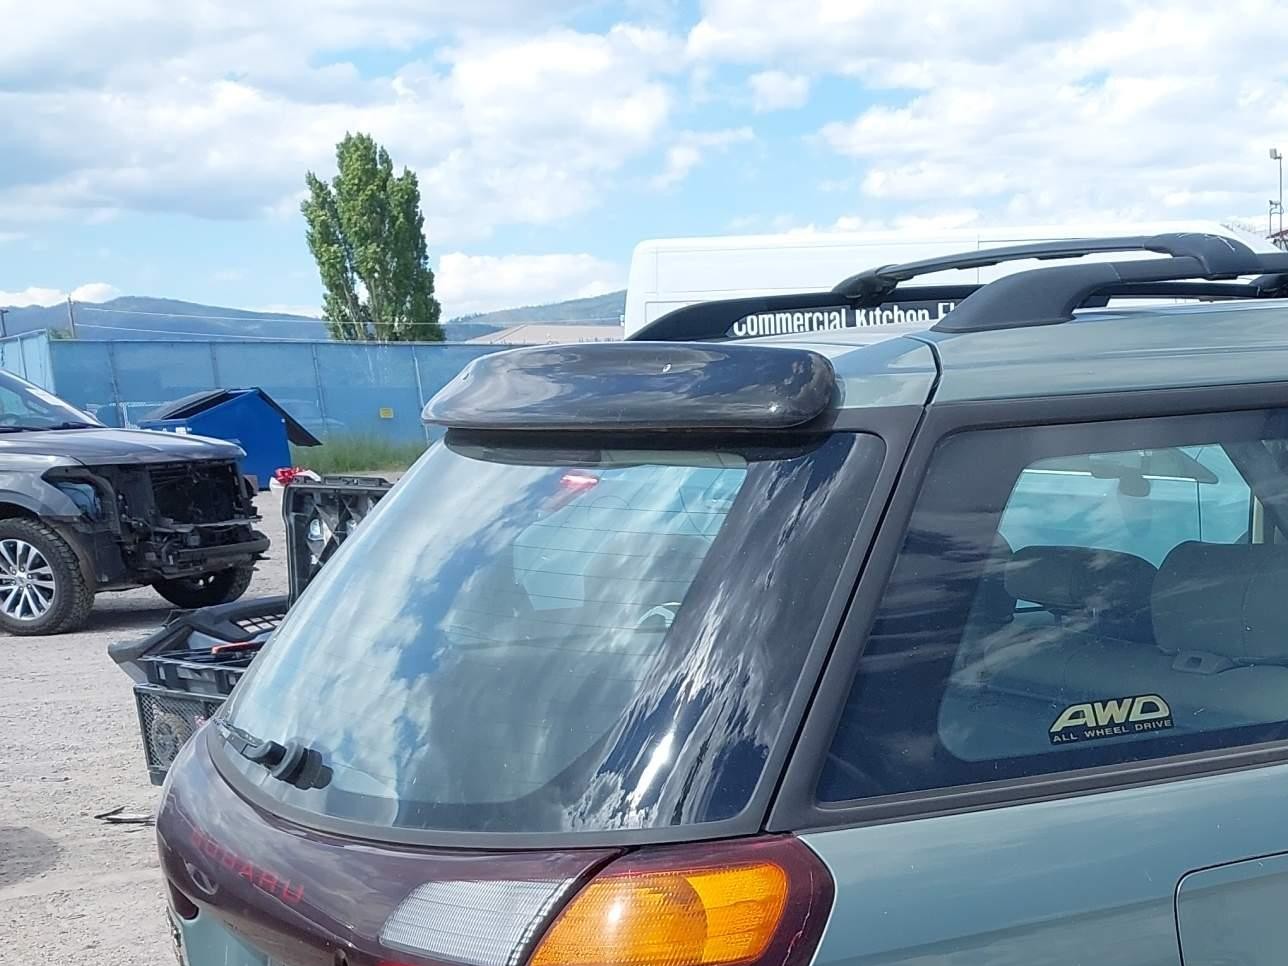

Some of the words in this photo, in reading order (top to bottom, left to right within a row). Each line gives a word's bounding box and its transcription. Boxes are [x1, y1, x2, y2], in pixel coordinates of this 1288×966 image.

[1050, 695, 1170, 732] AWD
[1053, 732, 1078, 743] ALL
[1084, 725, 1129, 738] WHEEL
[1134, 719, 1172, 732] DRIVE
